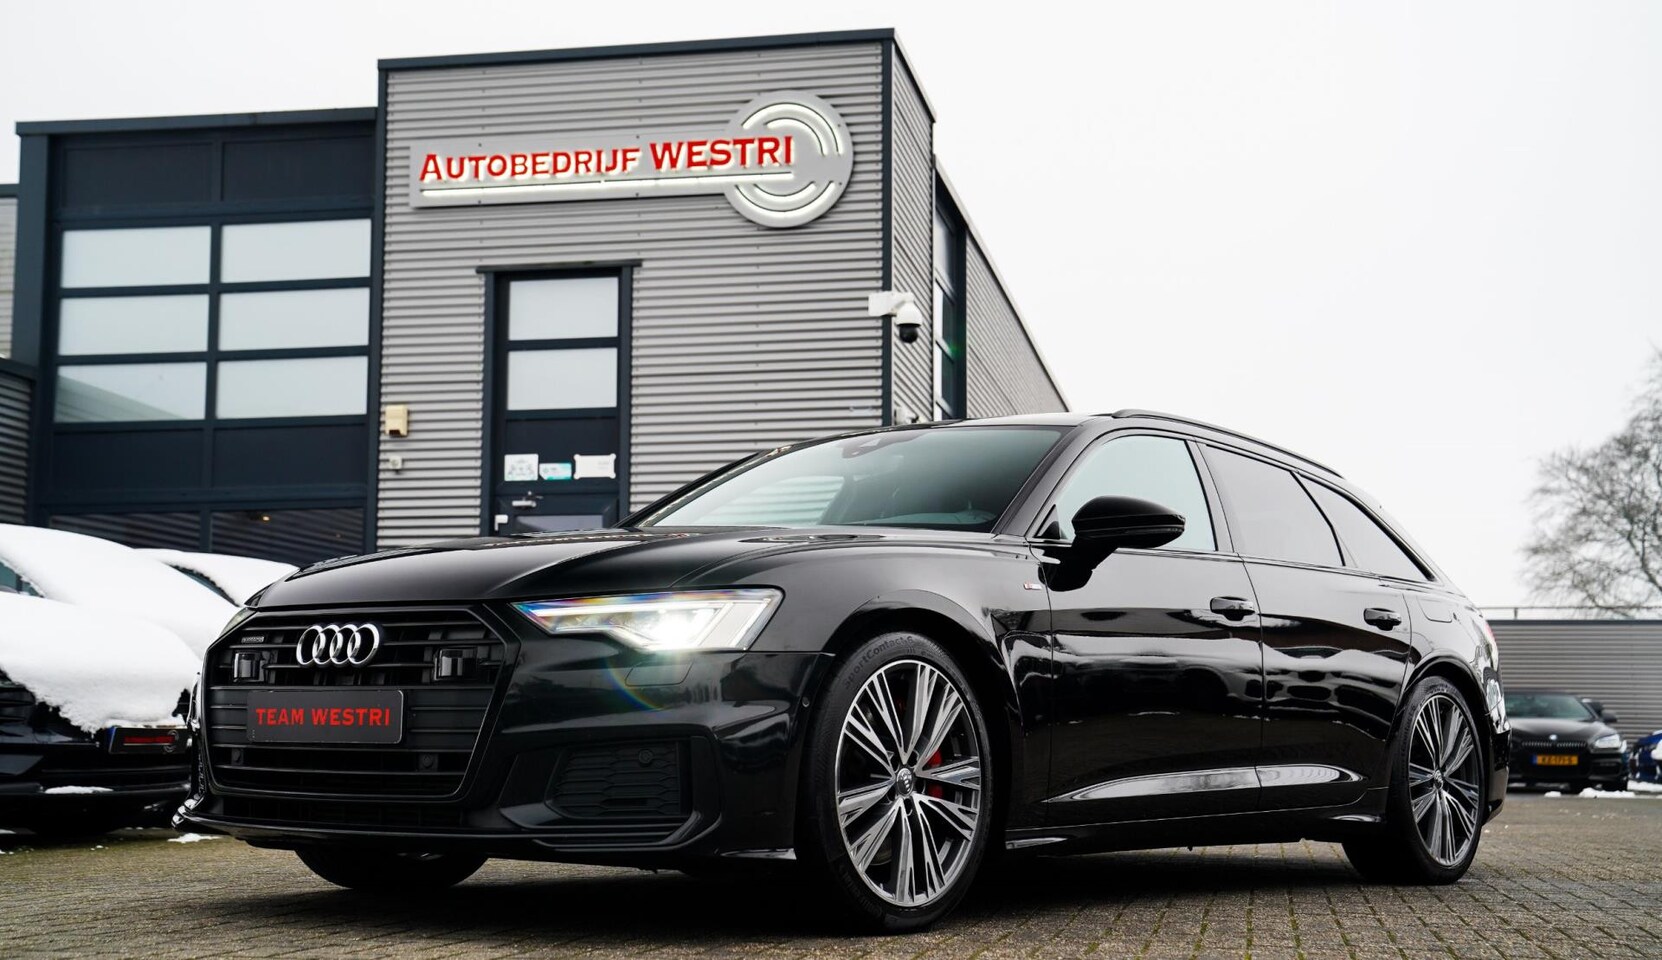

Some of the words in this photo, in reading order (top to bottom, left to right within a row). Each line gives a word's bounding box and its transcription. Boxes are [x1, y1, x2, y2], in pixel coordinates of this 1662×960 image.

[419, 147, 641, 182] AUTOBEDRIJF
[648, 135, 793, 171] WESTRI
[255, 707, 305, 726] TEAM
[311, 707, 391, 726] WESTRI
